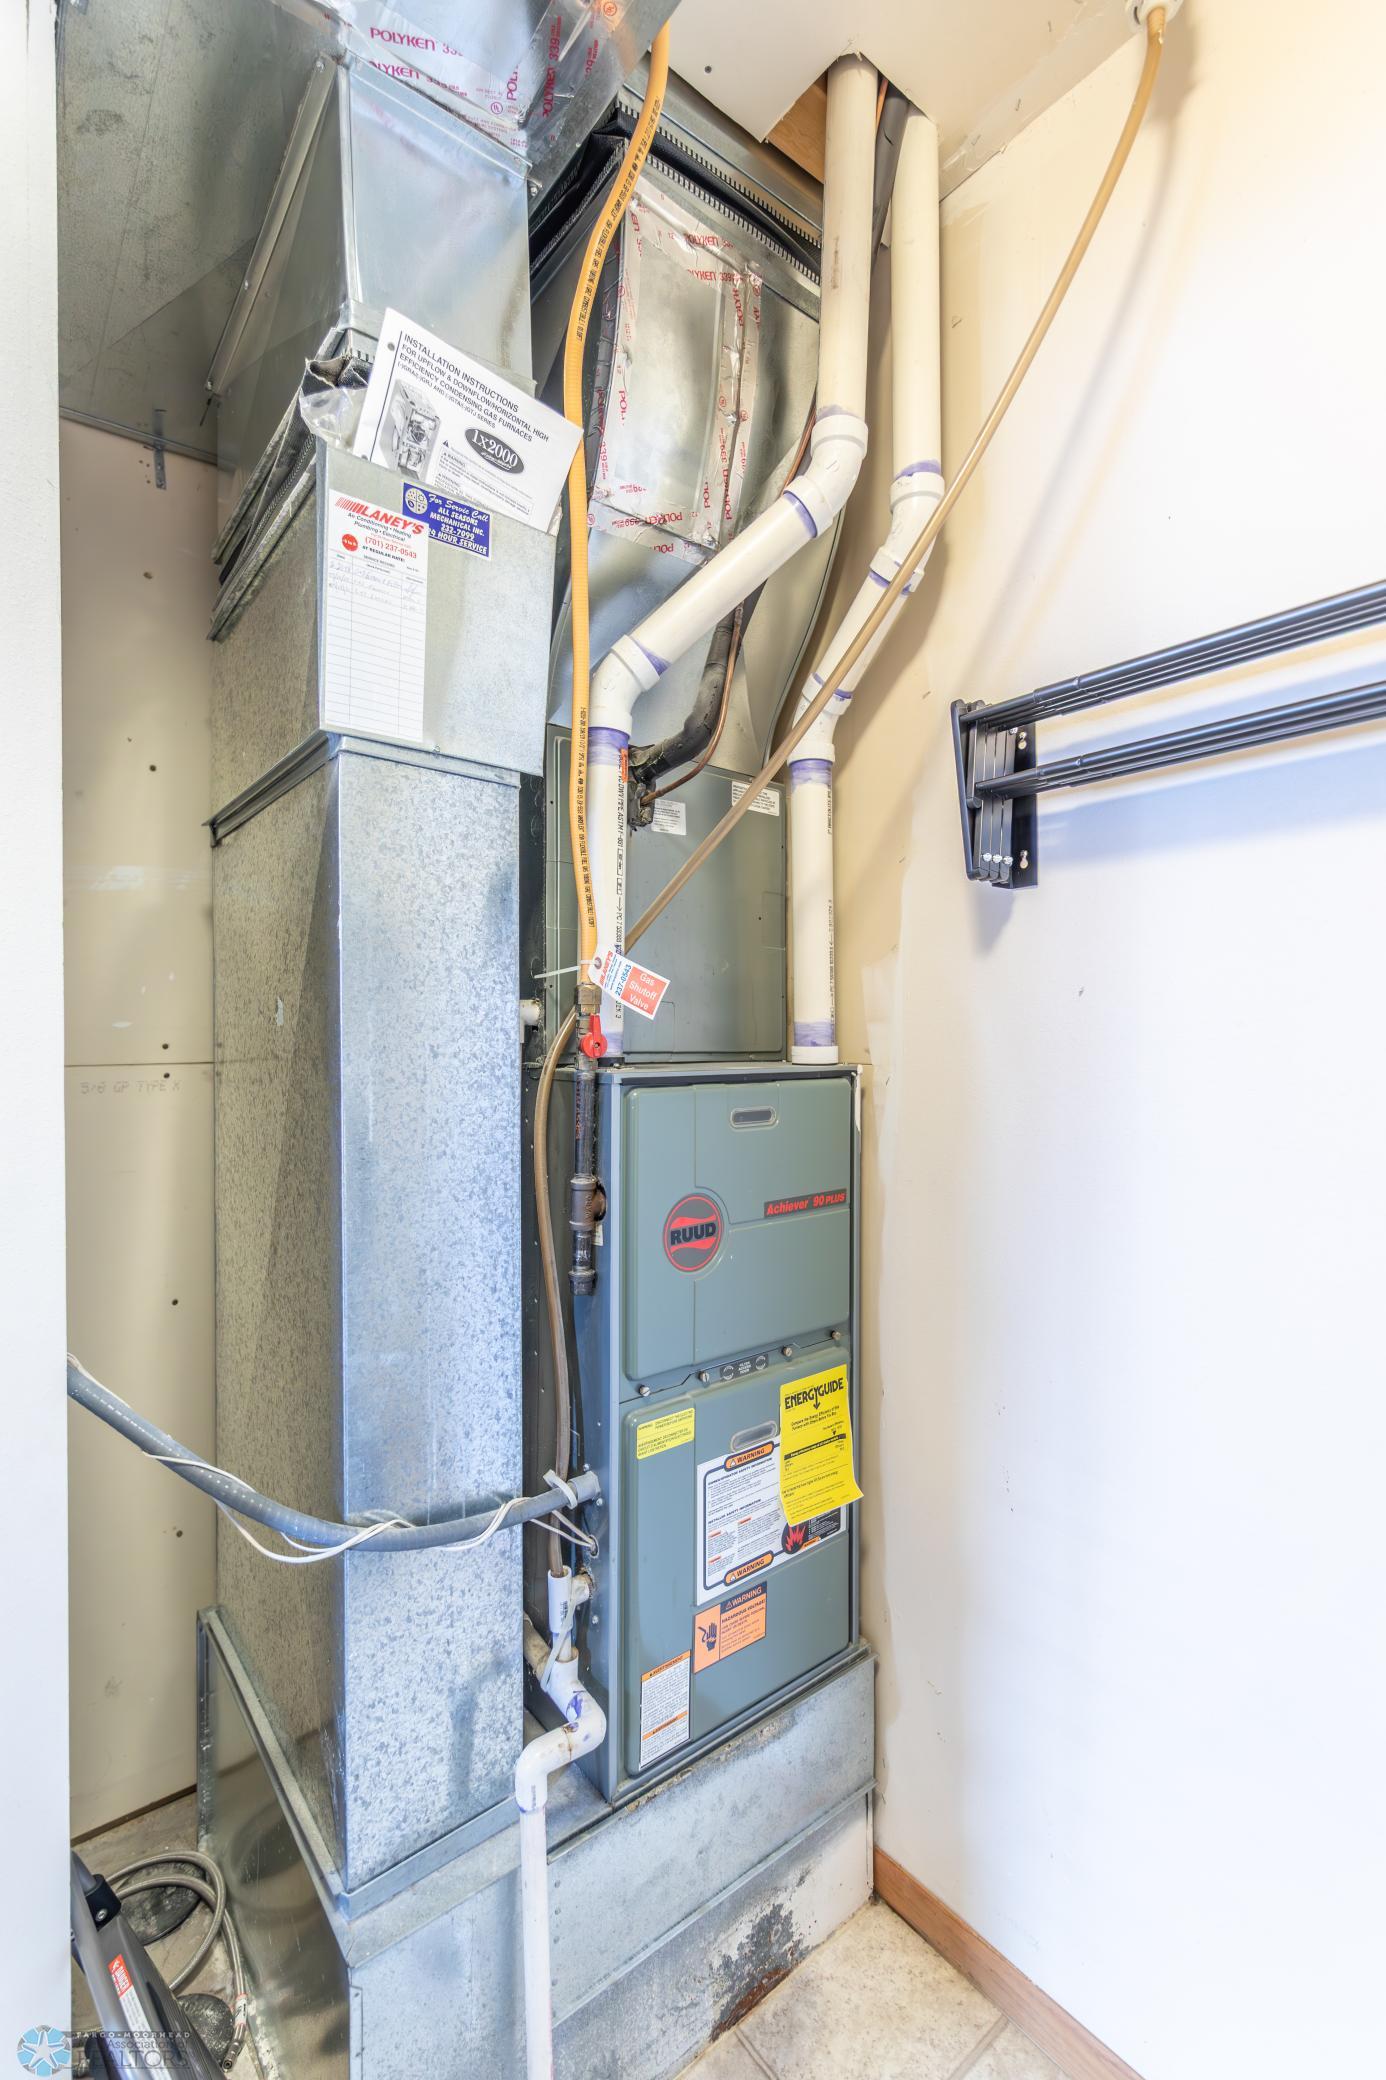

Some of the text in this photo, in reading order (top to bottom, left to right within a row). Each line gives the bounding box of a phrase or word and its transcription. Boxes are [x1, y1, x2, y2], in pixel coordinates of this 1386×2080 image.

[369, 26, 436, 51] POLYKEN
[404, 334, 461, 378] INSTALLATION
[461, 370, 518, 413] INSTRUCTIONS
[399, 353, 439, 385] EFFICIENCY
[439, 380, 484, 411] CONDENSING
[484, 407, 498, 422] GAS
[498, 417, 533, 442] FURNACES
[402, 344, 417, 358] FOR
[417, 352, 447, 377] UPFLOW
[446, 374, 452, 382] &
[453, 378, 532, 433] DOWNFLOW/HORIZONTAL
[532, 428, 549, 442] HIGH
[360, 505, 425, 535] LANEY'S
[428, 493, 442, 506] For
[471, 511, 489, 523] Call
[438, 507, 478, 526] ALL SEASONS
[354, 520, 379, 534] Plumbing
[382, 530, 406, 542] Electrical
[356, 515, 389, 531] Conditioning
[393, 527, 412, 539] Heating
[429, 512, 485, 537] MECHANICAL INC.
[441, 523, 475, 540] 232-7099
[365, 535, 383, 548] (701)
[385, 542, 417, 559] 237-0543
[437, 531, 458, 546] HOUR
[458, 538, 488, 555] SERVICE
[615, 964, 632, 996] 237-0543
[629, 982, 657, 1000] Shutoff
[639, 973, 655, 986] Gas
[630, 994, 649, 1010] Valve
[766, 1193, 845, 1216] Achiever 90 PLUS
[670, 1222, 716, 1246] RUUD
[784, 1377, 844, 1410] ENERGYGUIDE
[737, 1448, 765, 1463] WARNING
[736, 1558, 765, 1576] WARNING
[732, 1586, 762, 1606] WARNING
